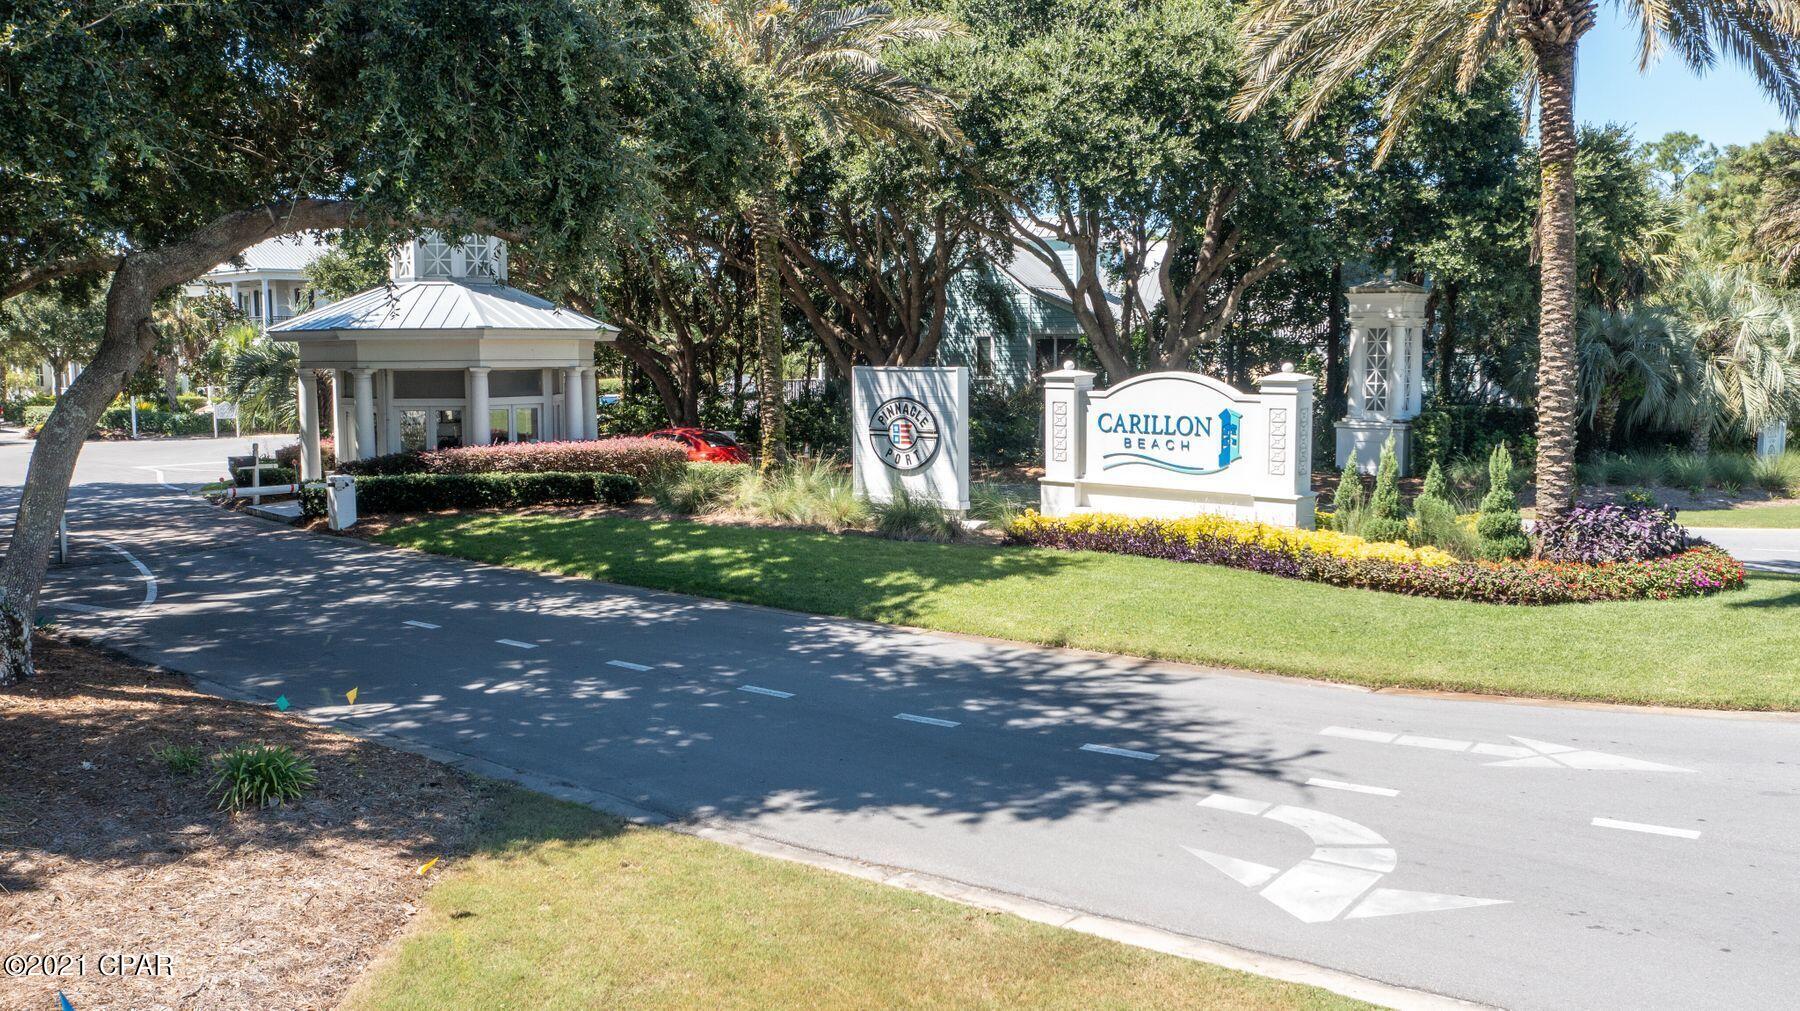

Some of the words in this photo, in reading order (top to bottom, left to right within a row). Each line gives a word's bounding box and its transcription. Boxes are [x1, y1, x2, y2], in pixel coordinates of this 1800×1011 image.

[878, 402, 929, 428] PINNACLE
[1097, 412, 1213, 437] CARILLON
[1123, 437, 1191, 451] BEACH
[885, 447, 921, 465] PORT
